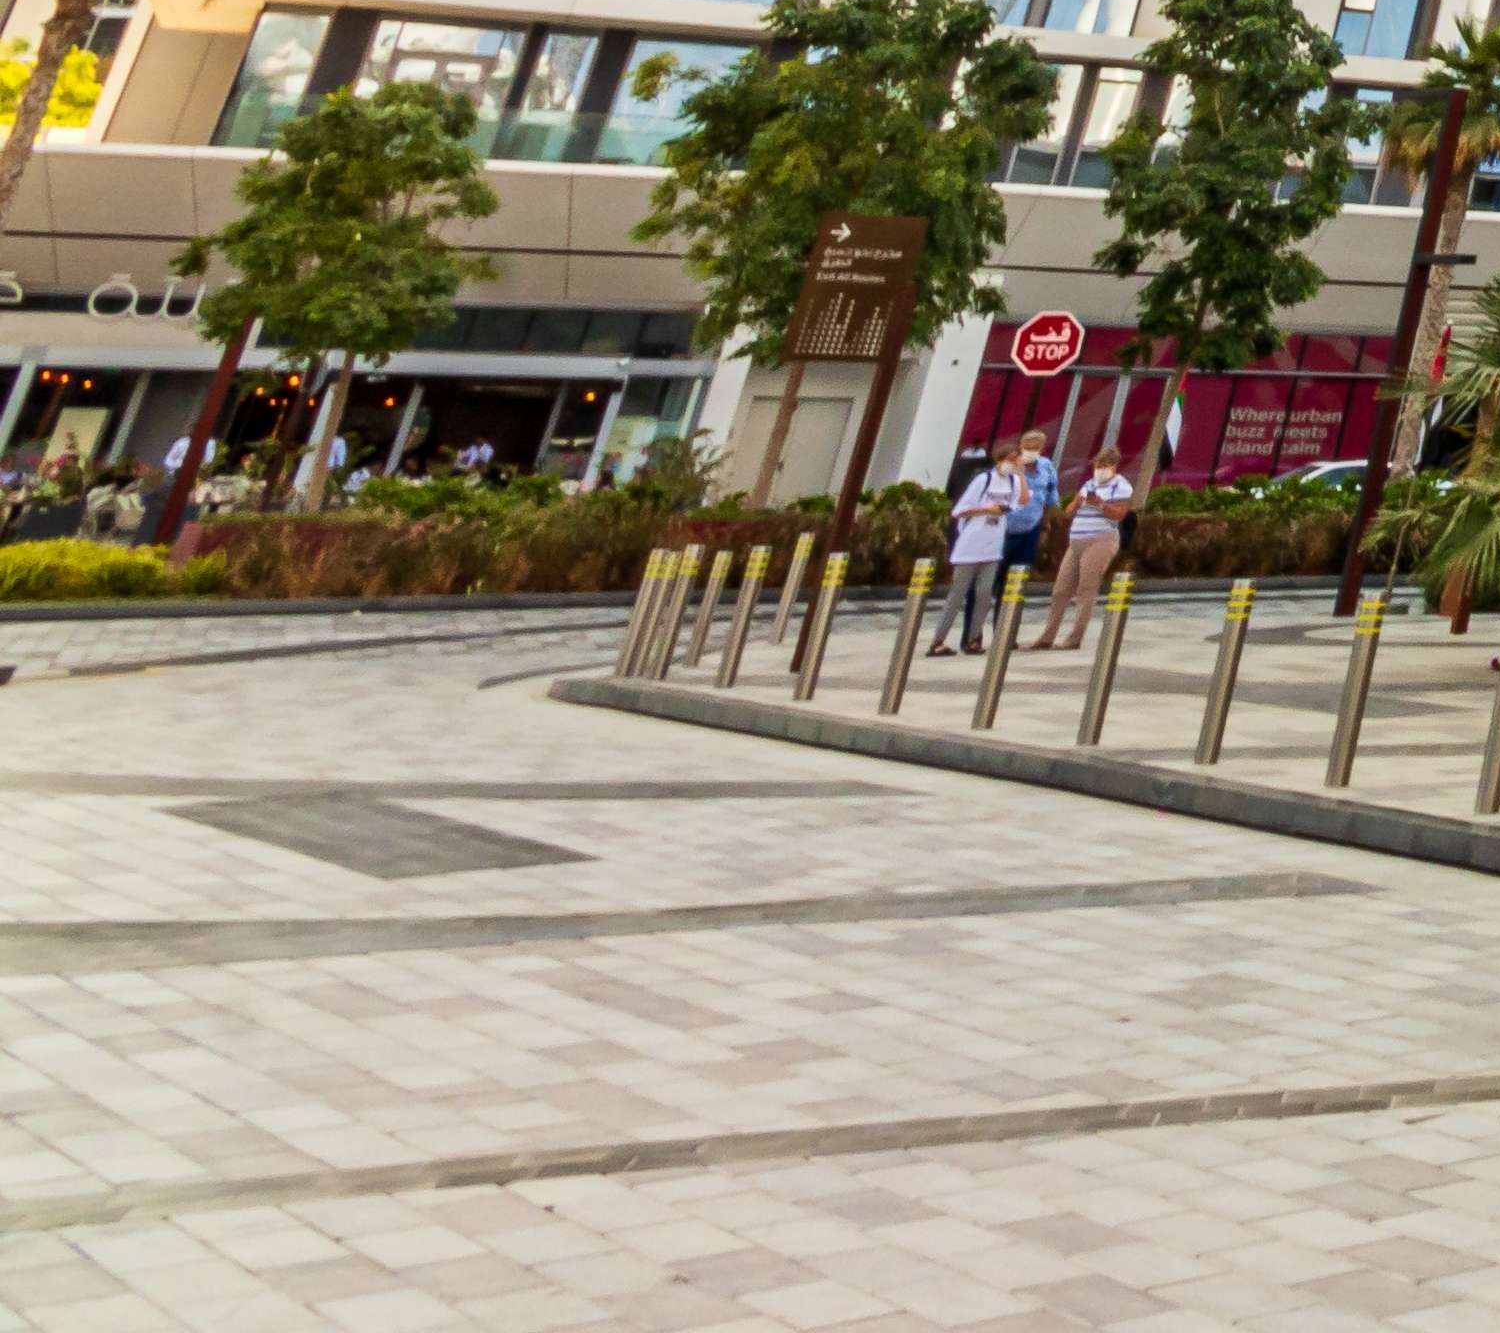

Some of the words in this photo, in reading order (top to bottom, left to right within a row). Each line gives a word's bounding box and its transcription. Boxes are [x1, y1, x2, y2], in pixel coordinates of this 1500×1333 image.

[1029, 321, 1072, 343] قف
[1023, 343, 1070, 361] STOP
[1230, 406, 1286, 423] Where
[1289, 408, 1342, 423] urban
[1225, 423, 1265, 438] buzz
